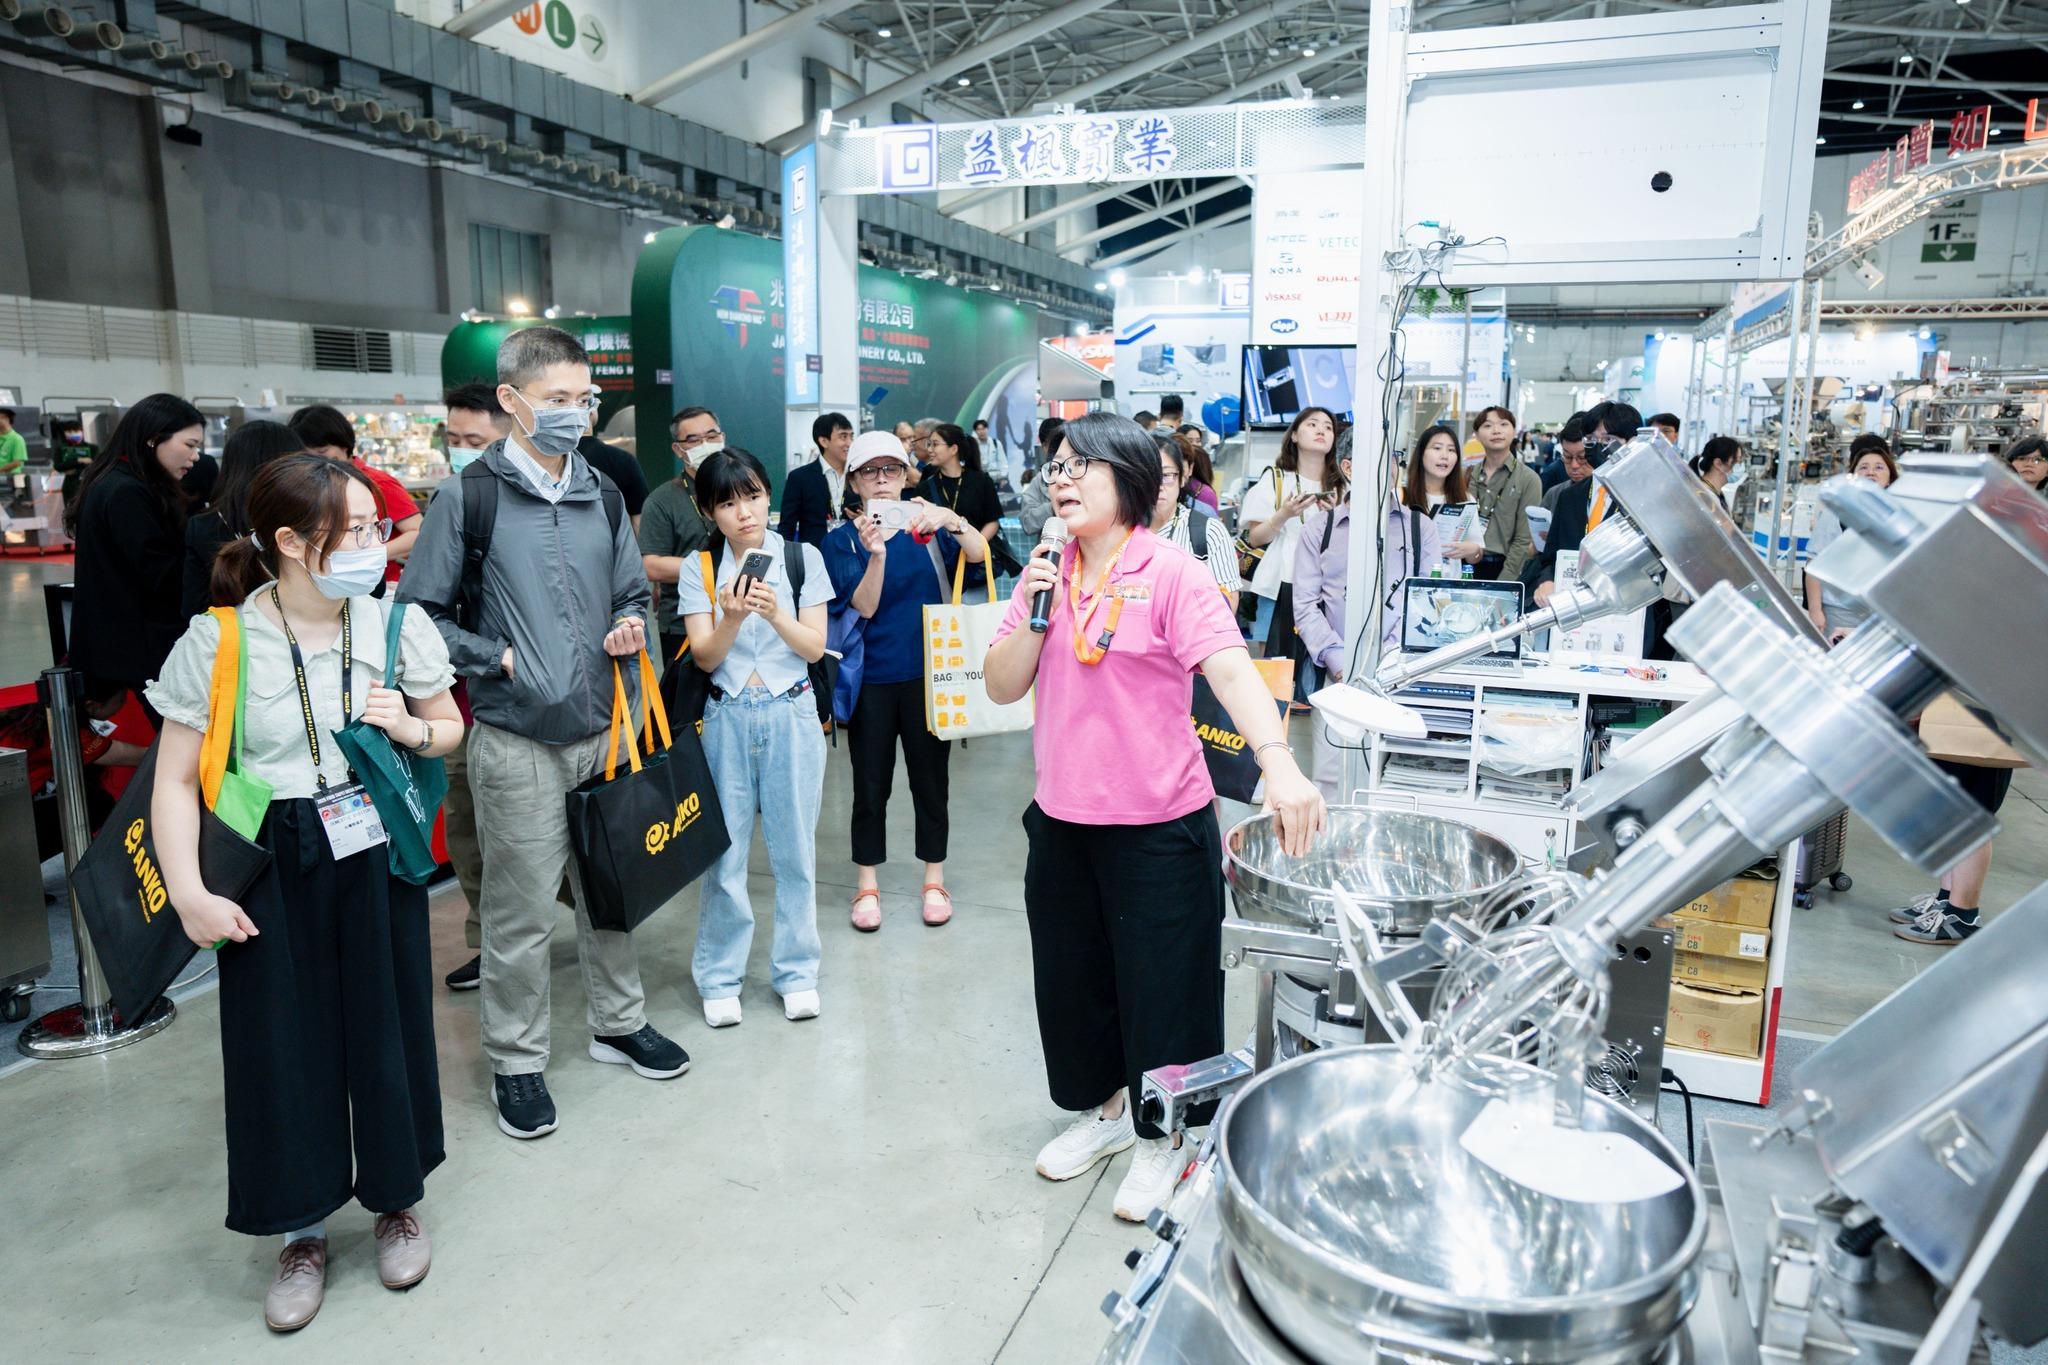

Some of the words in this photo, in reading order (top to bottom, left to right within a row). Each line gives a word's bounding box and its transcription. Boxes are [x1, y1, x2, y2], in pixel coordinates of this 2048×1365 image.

[552, 6, 568, 42] L
[1928, 223, 1961, 241] 1F
[1269, 266, 1303, 275] NOMA
[1264, 291, 1303, 302] VISKASE
[906, 351, 926, 364] LTD.
[933, 672, 953, 683] BAG
[965, 671, 984, 680] YOU
[1196, 723, 1247, 751] ANKO
[133, 846, 167, 914] ANKO
[1691, 902, 1709, 913] C12
[1686, 940, 1699, 950] C8
[1686, 966, 1699, 976] C8
